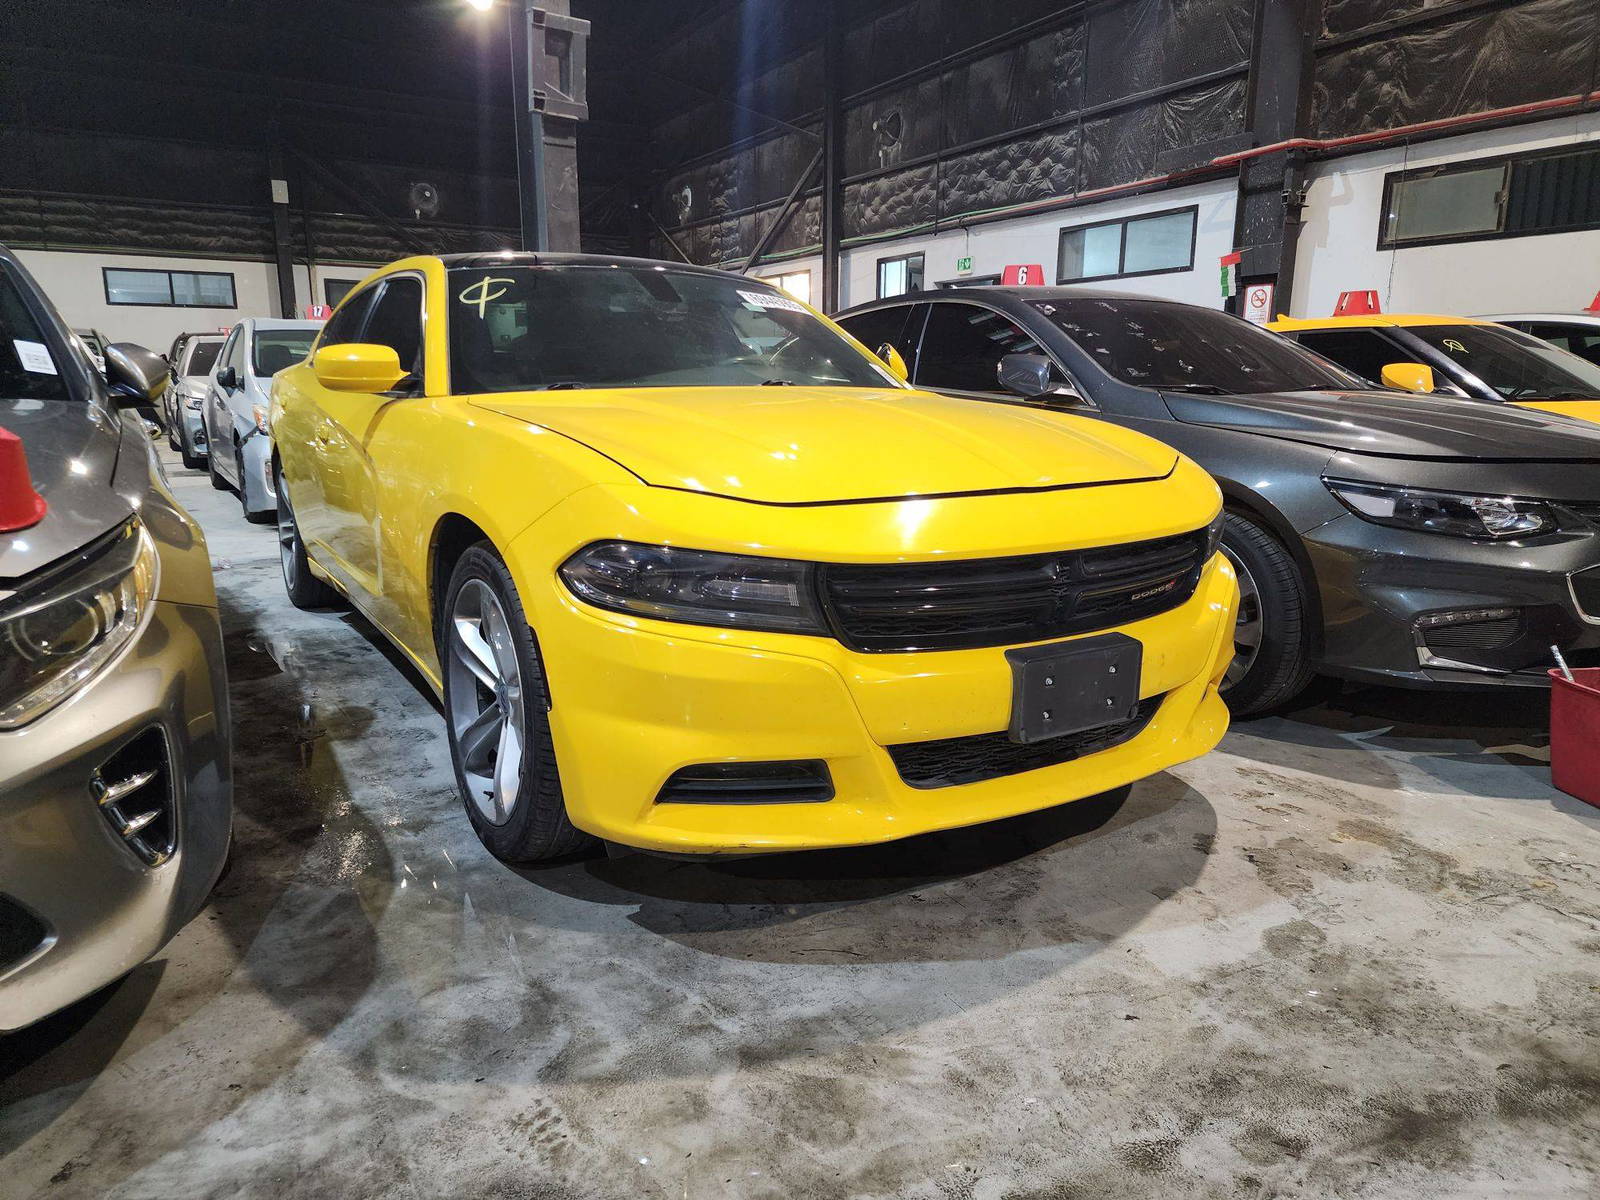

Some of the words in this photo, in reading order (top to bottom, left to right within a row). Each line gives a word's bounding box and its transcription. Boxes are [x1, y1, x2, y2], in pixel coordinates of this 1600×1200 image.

[1018, 266, 1028, 285] 6
[313, 305, 323, 317] 17
[1131, 583, 1173, 600] DODGE
